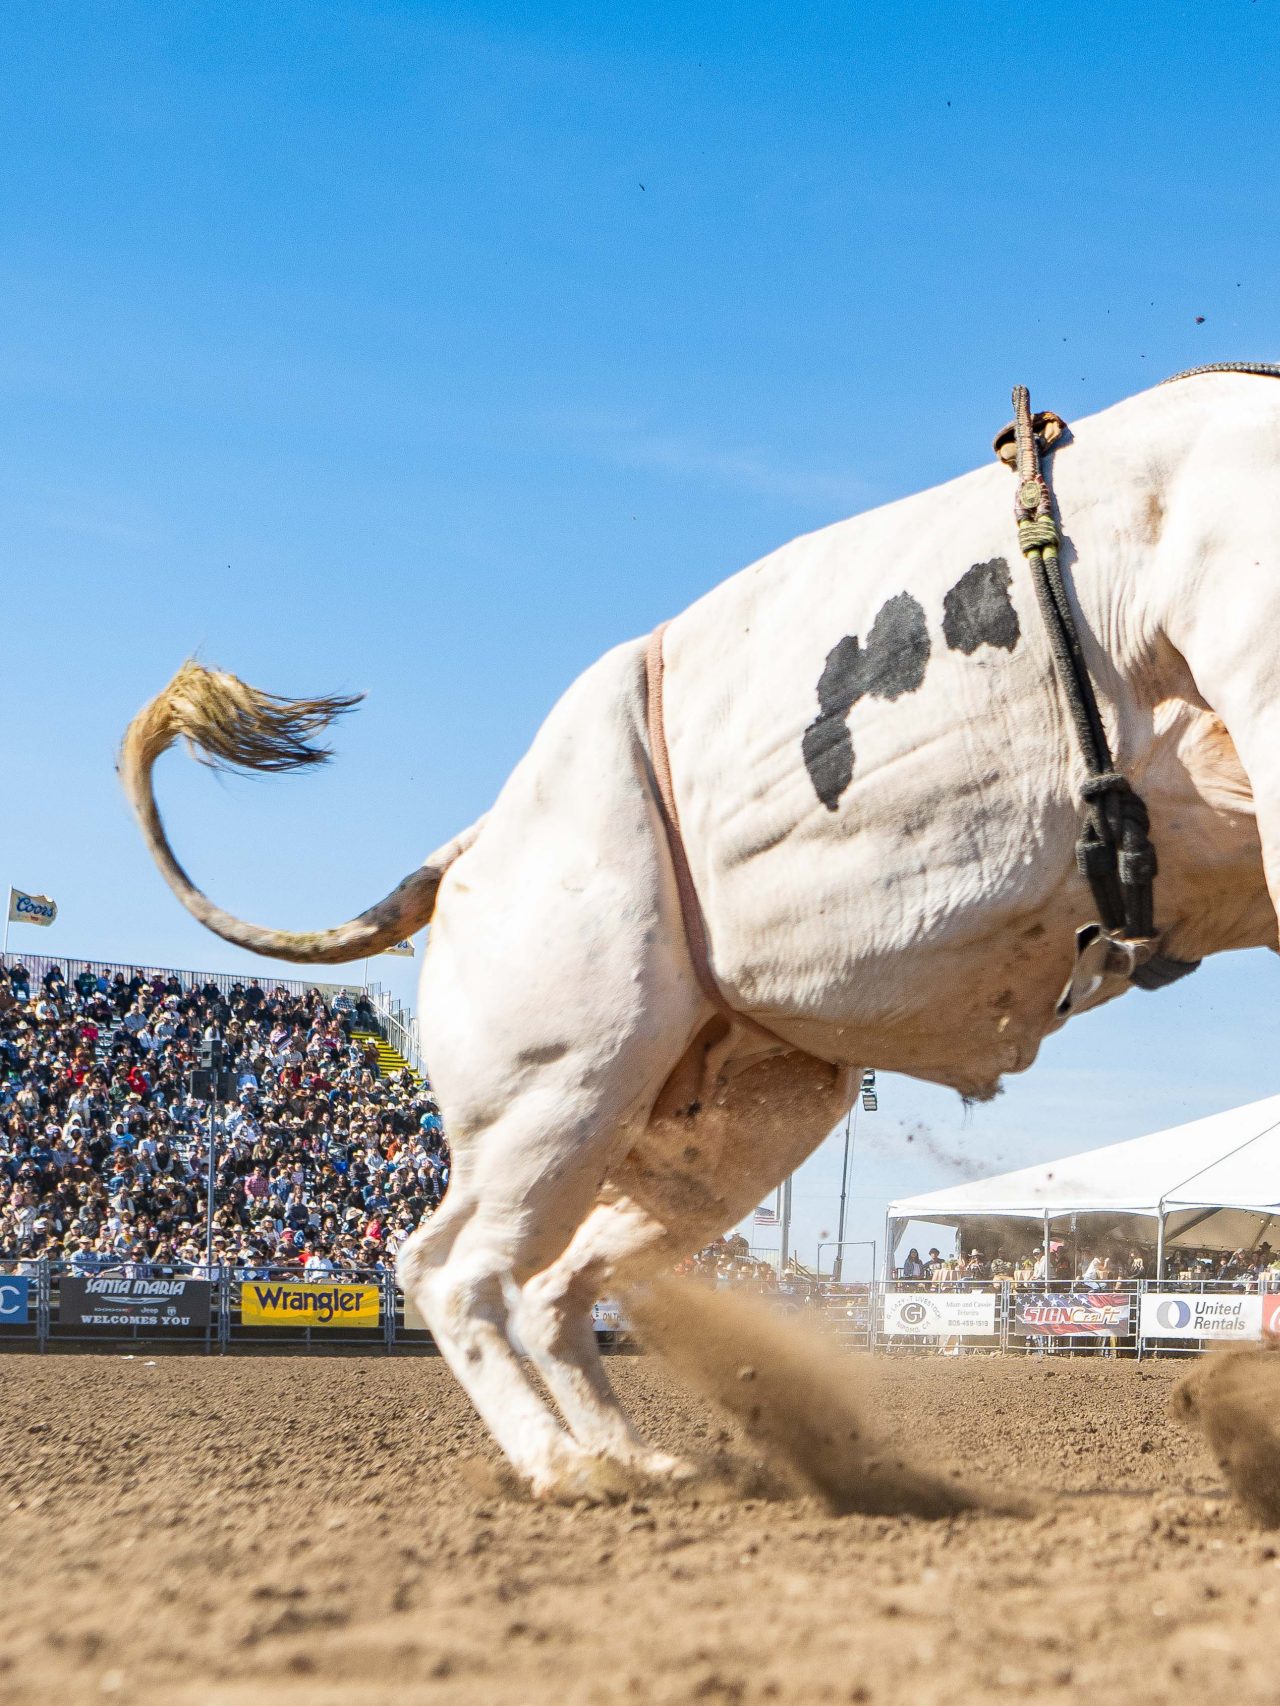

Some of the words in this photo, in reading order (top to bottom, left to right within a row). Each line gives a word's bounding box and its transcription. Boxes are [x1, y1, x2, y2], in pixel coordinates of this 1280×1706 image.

[16, 896, 54, 918] Coors
[85, 1279, 129, 1295] SANTA
[133, 1281, 186, 1296] MARIA
[254, 1286, 364, 1323] Wrangler
[1195, 1302, 1242, 1315] United
[80, 1315, 158, 1325] WELCOMES
[162, 1316, 191, 1326] YOU
[1194, 1316, 1246, 1331] Rentals
